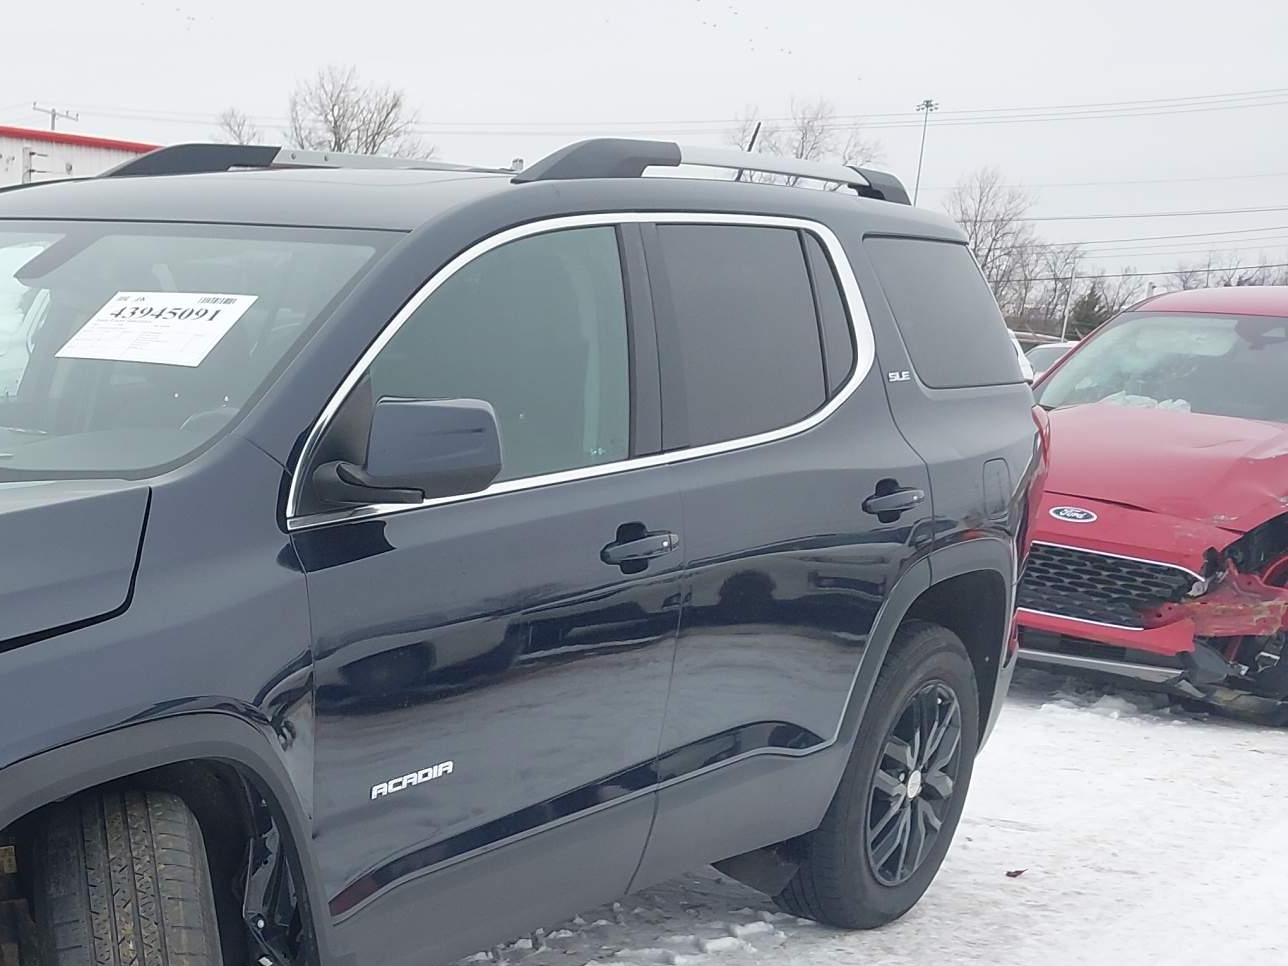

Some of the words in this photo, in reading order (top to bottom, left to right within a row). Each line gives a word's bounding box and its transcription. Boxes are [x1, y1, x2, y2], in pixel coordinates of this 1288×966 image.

[110, 306, 222, 322] 43945091
[888, 370, 911, 382] SLE
[1056, 507, 1091, 520] Ford
[371, 760, 454, 800] ACADIA
